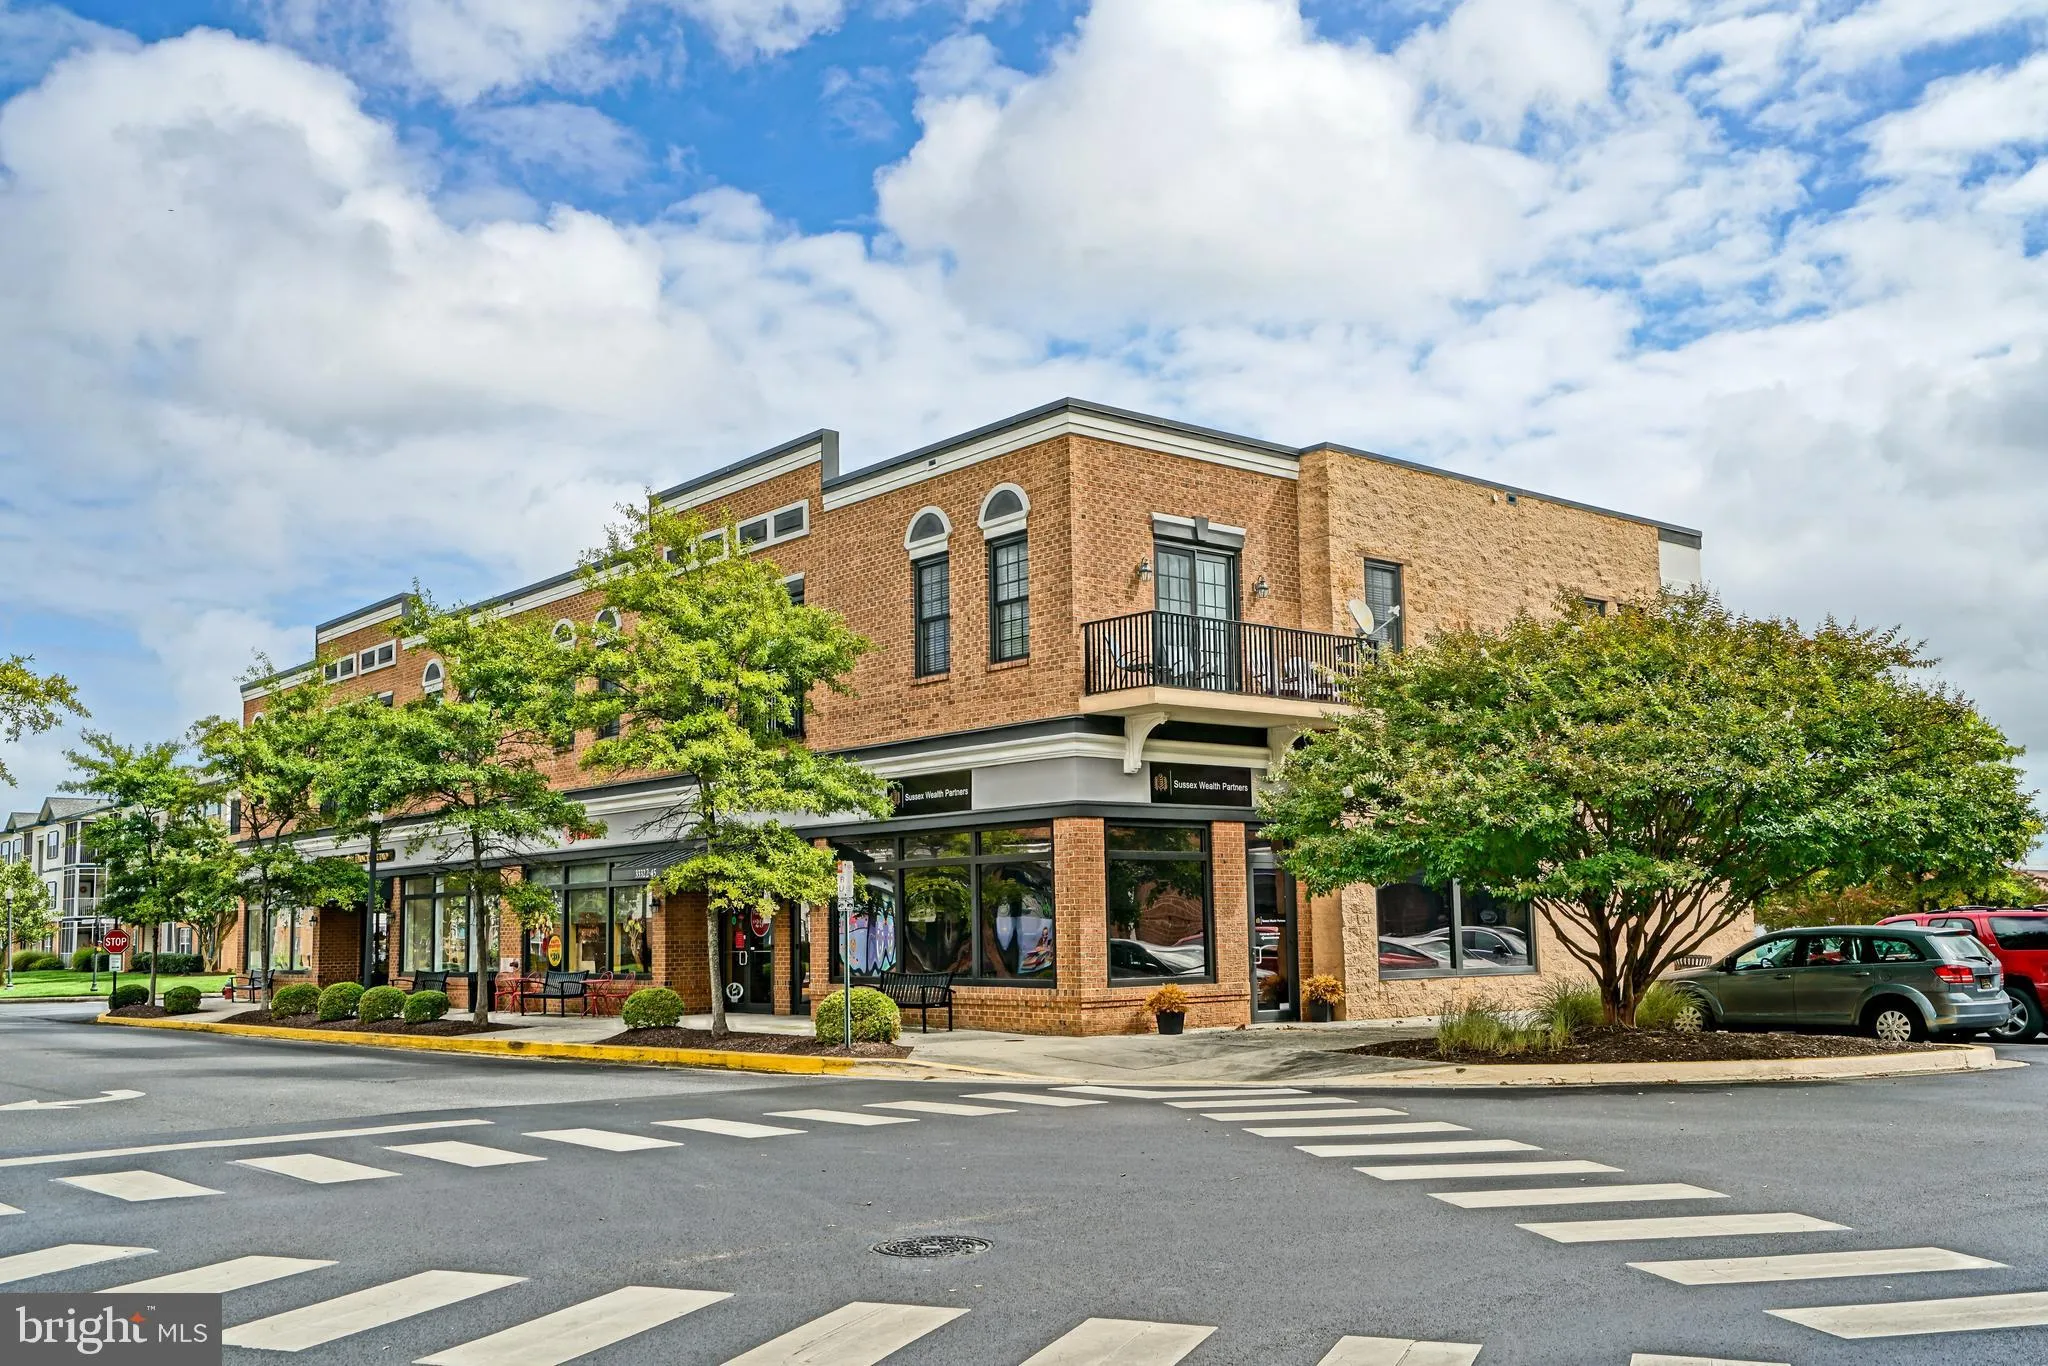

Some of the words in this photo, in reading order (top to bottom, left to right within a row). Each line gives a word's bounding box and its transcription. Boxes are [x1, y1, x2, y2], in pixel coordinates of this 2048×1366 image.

[1173, 779, 1198, 789] Sussex
[1199, 780, 1221, 791] Wealth
[1222, 782, 1249, 792] Partners
[904, 793, 925, 802] Sussex
[925, 790, 944, 799] Wealth
[944, 788, 969, 797] Partners
[105, 937, 127, 947] STOP
